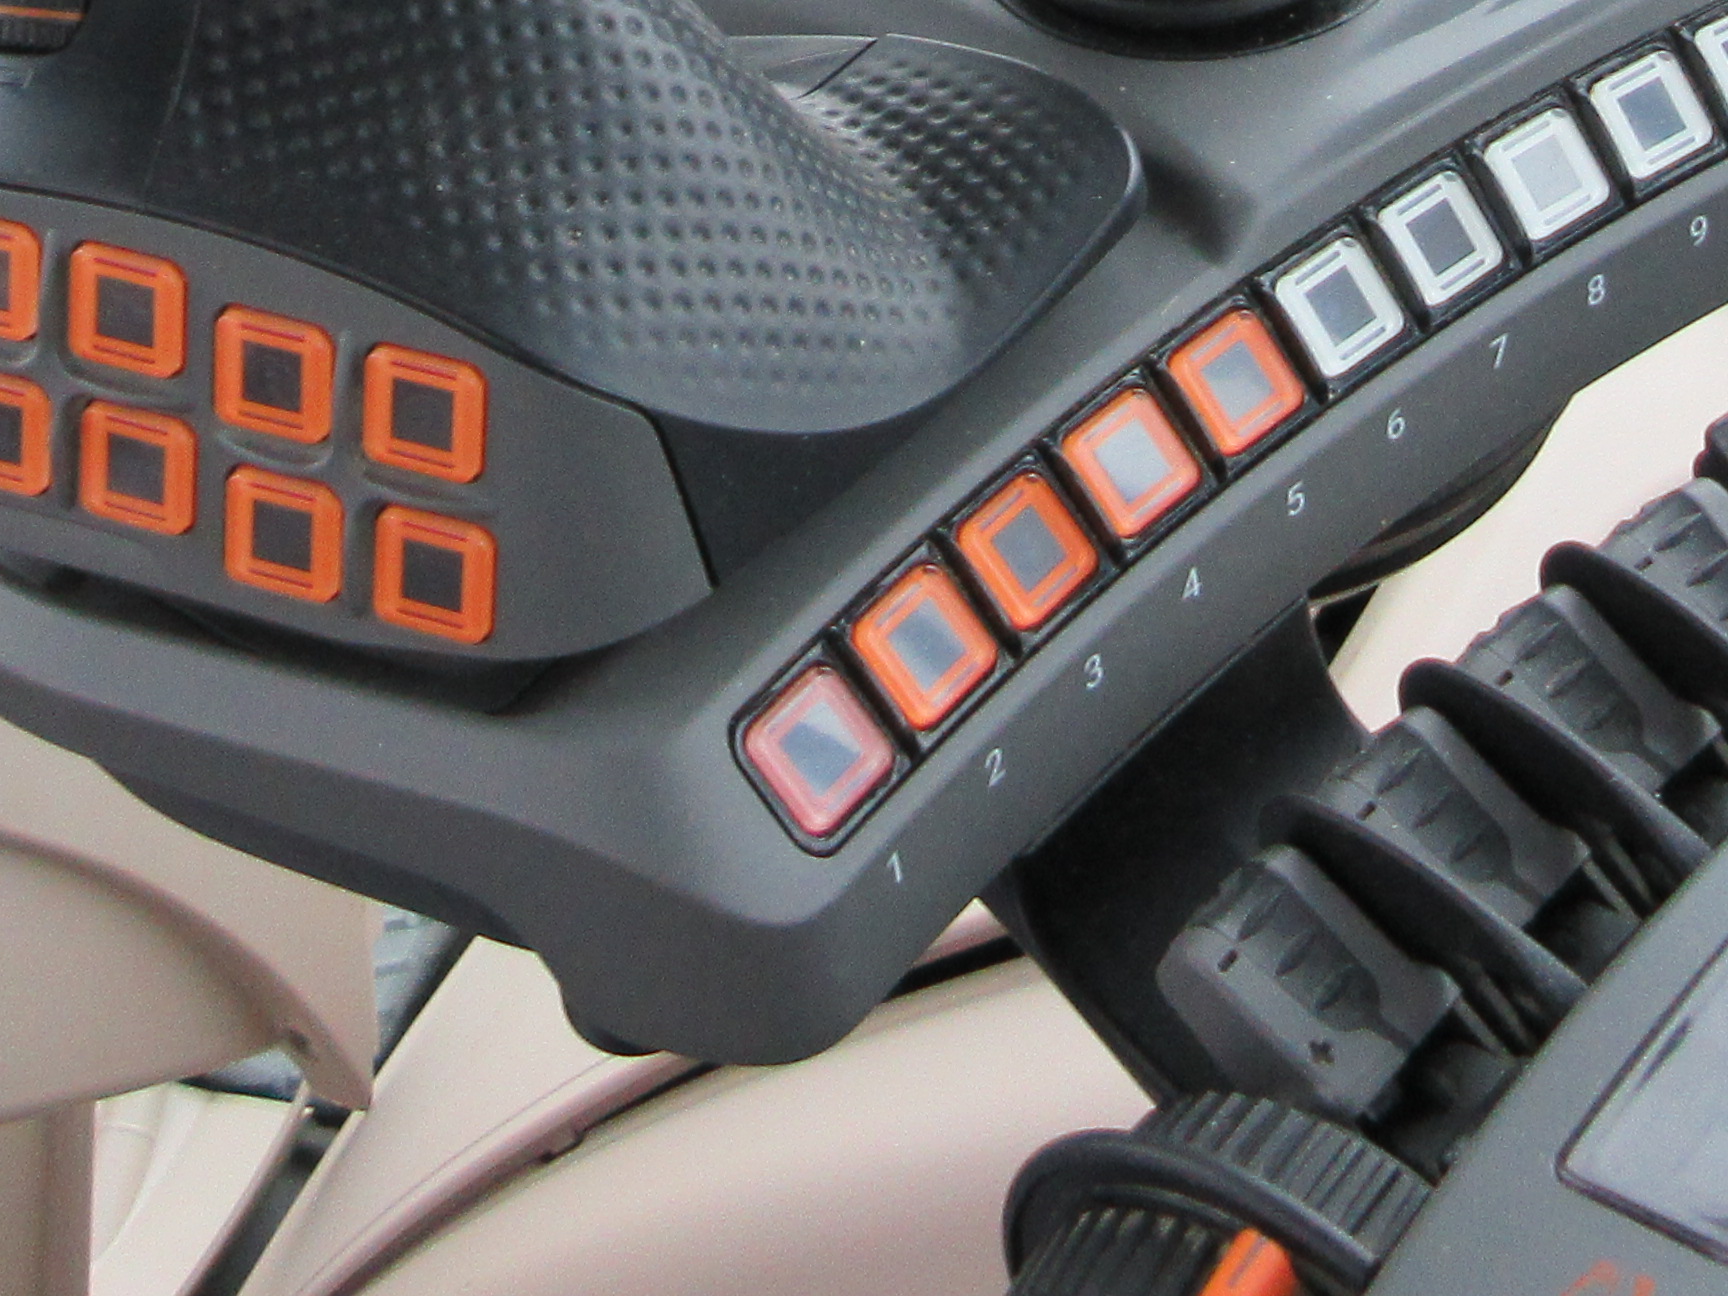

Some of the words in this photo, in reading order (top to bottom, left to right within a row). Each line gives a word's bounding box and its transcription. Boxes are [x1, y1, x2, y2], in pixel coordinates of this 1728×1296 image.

[886, 851, 903, 884] 1
[984, 747, 1006, 787] 2
[1083, 652, 1104, 690] 3
[1182, 566, 1202, 600] 4
[1286, 481, 1306, 517] 5
[1386, 408, 1407, 441] 6
[1489, 333, 1509, 369] 7
[1586, 273, 1607, 307] 8
[1689, 214, 1709, 246] 9
